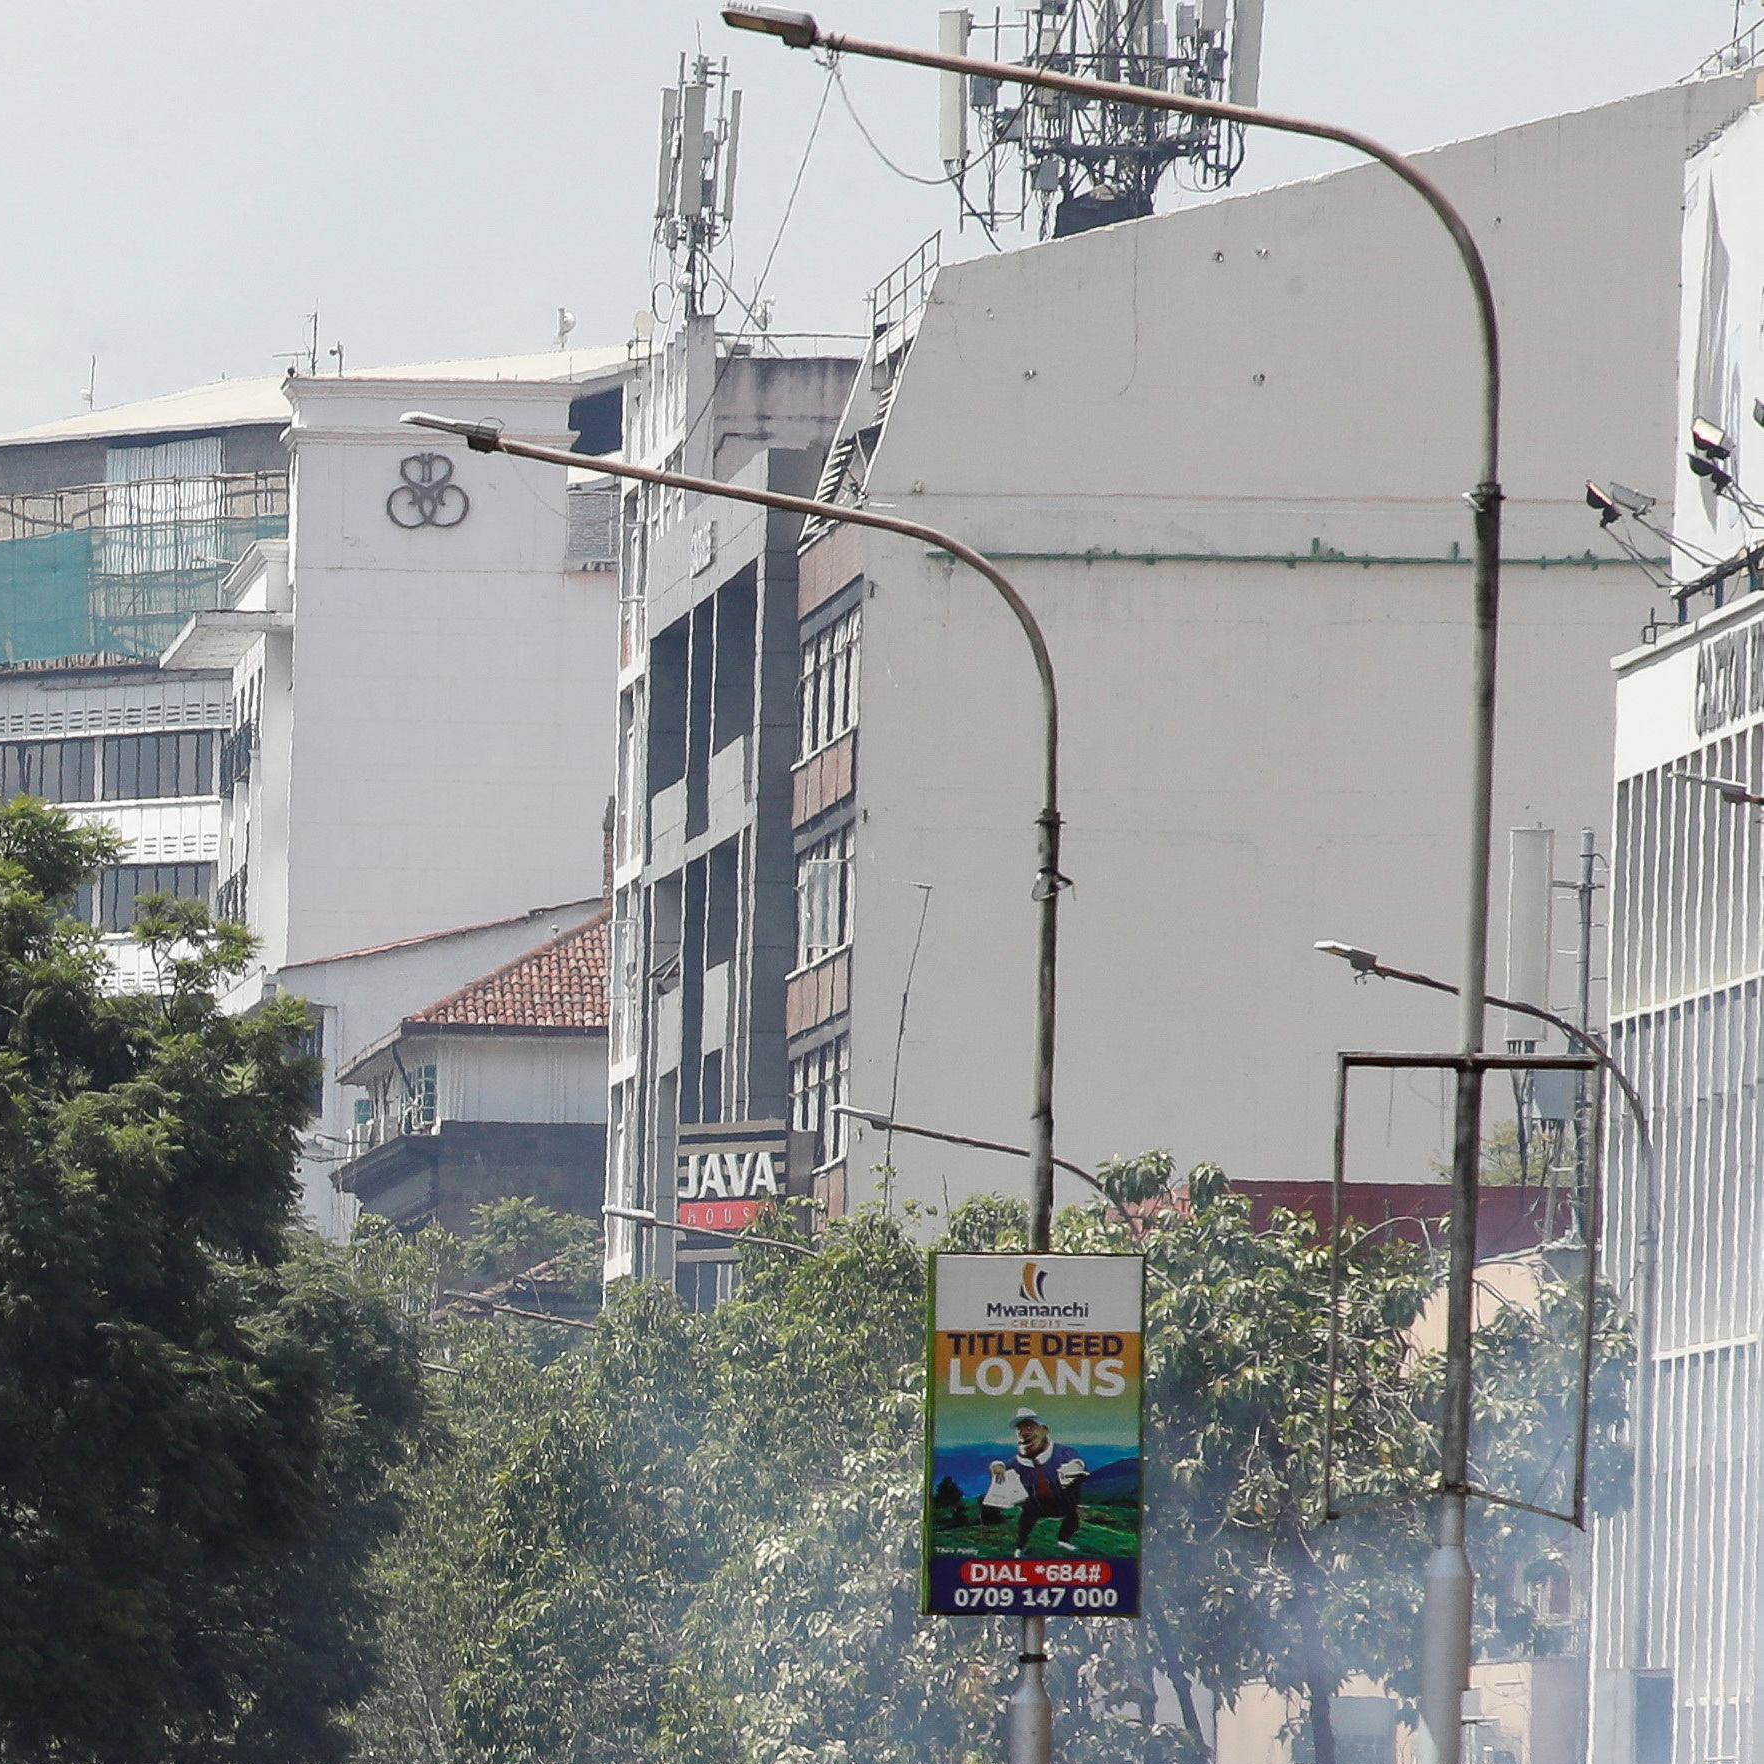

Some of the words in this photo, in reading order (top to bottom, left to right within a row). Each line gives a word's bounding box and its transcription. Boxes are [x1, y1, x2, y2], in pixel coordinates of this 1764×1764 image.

[677, 1151, 779, 1199] JAVA
[686, 1206, 754, 1226] HOUS
[986, 1301, 1089, 1319] Mwananchi
[1011, 1319, 1062, 1329] CREDIT
[947, 1332, 1031, 1356] TITLE
[1042, 1334, 1124, 1357] DEED
[948, 1357, 1126, 1397] LOANS
[970, 1563, 1027, 1583] DIAL
[954, 1587, 1015, 1608] 0709
[1022, 1588, 1065, 1608] 147
[1073, 1587, 1119, 1608] 000
